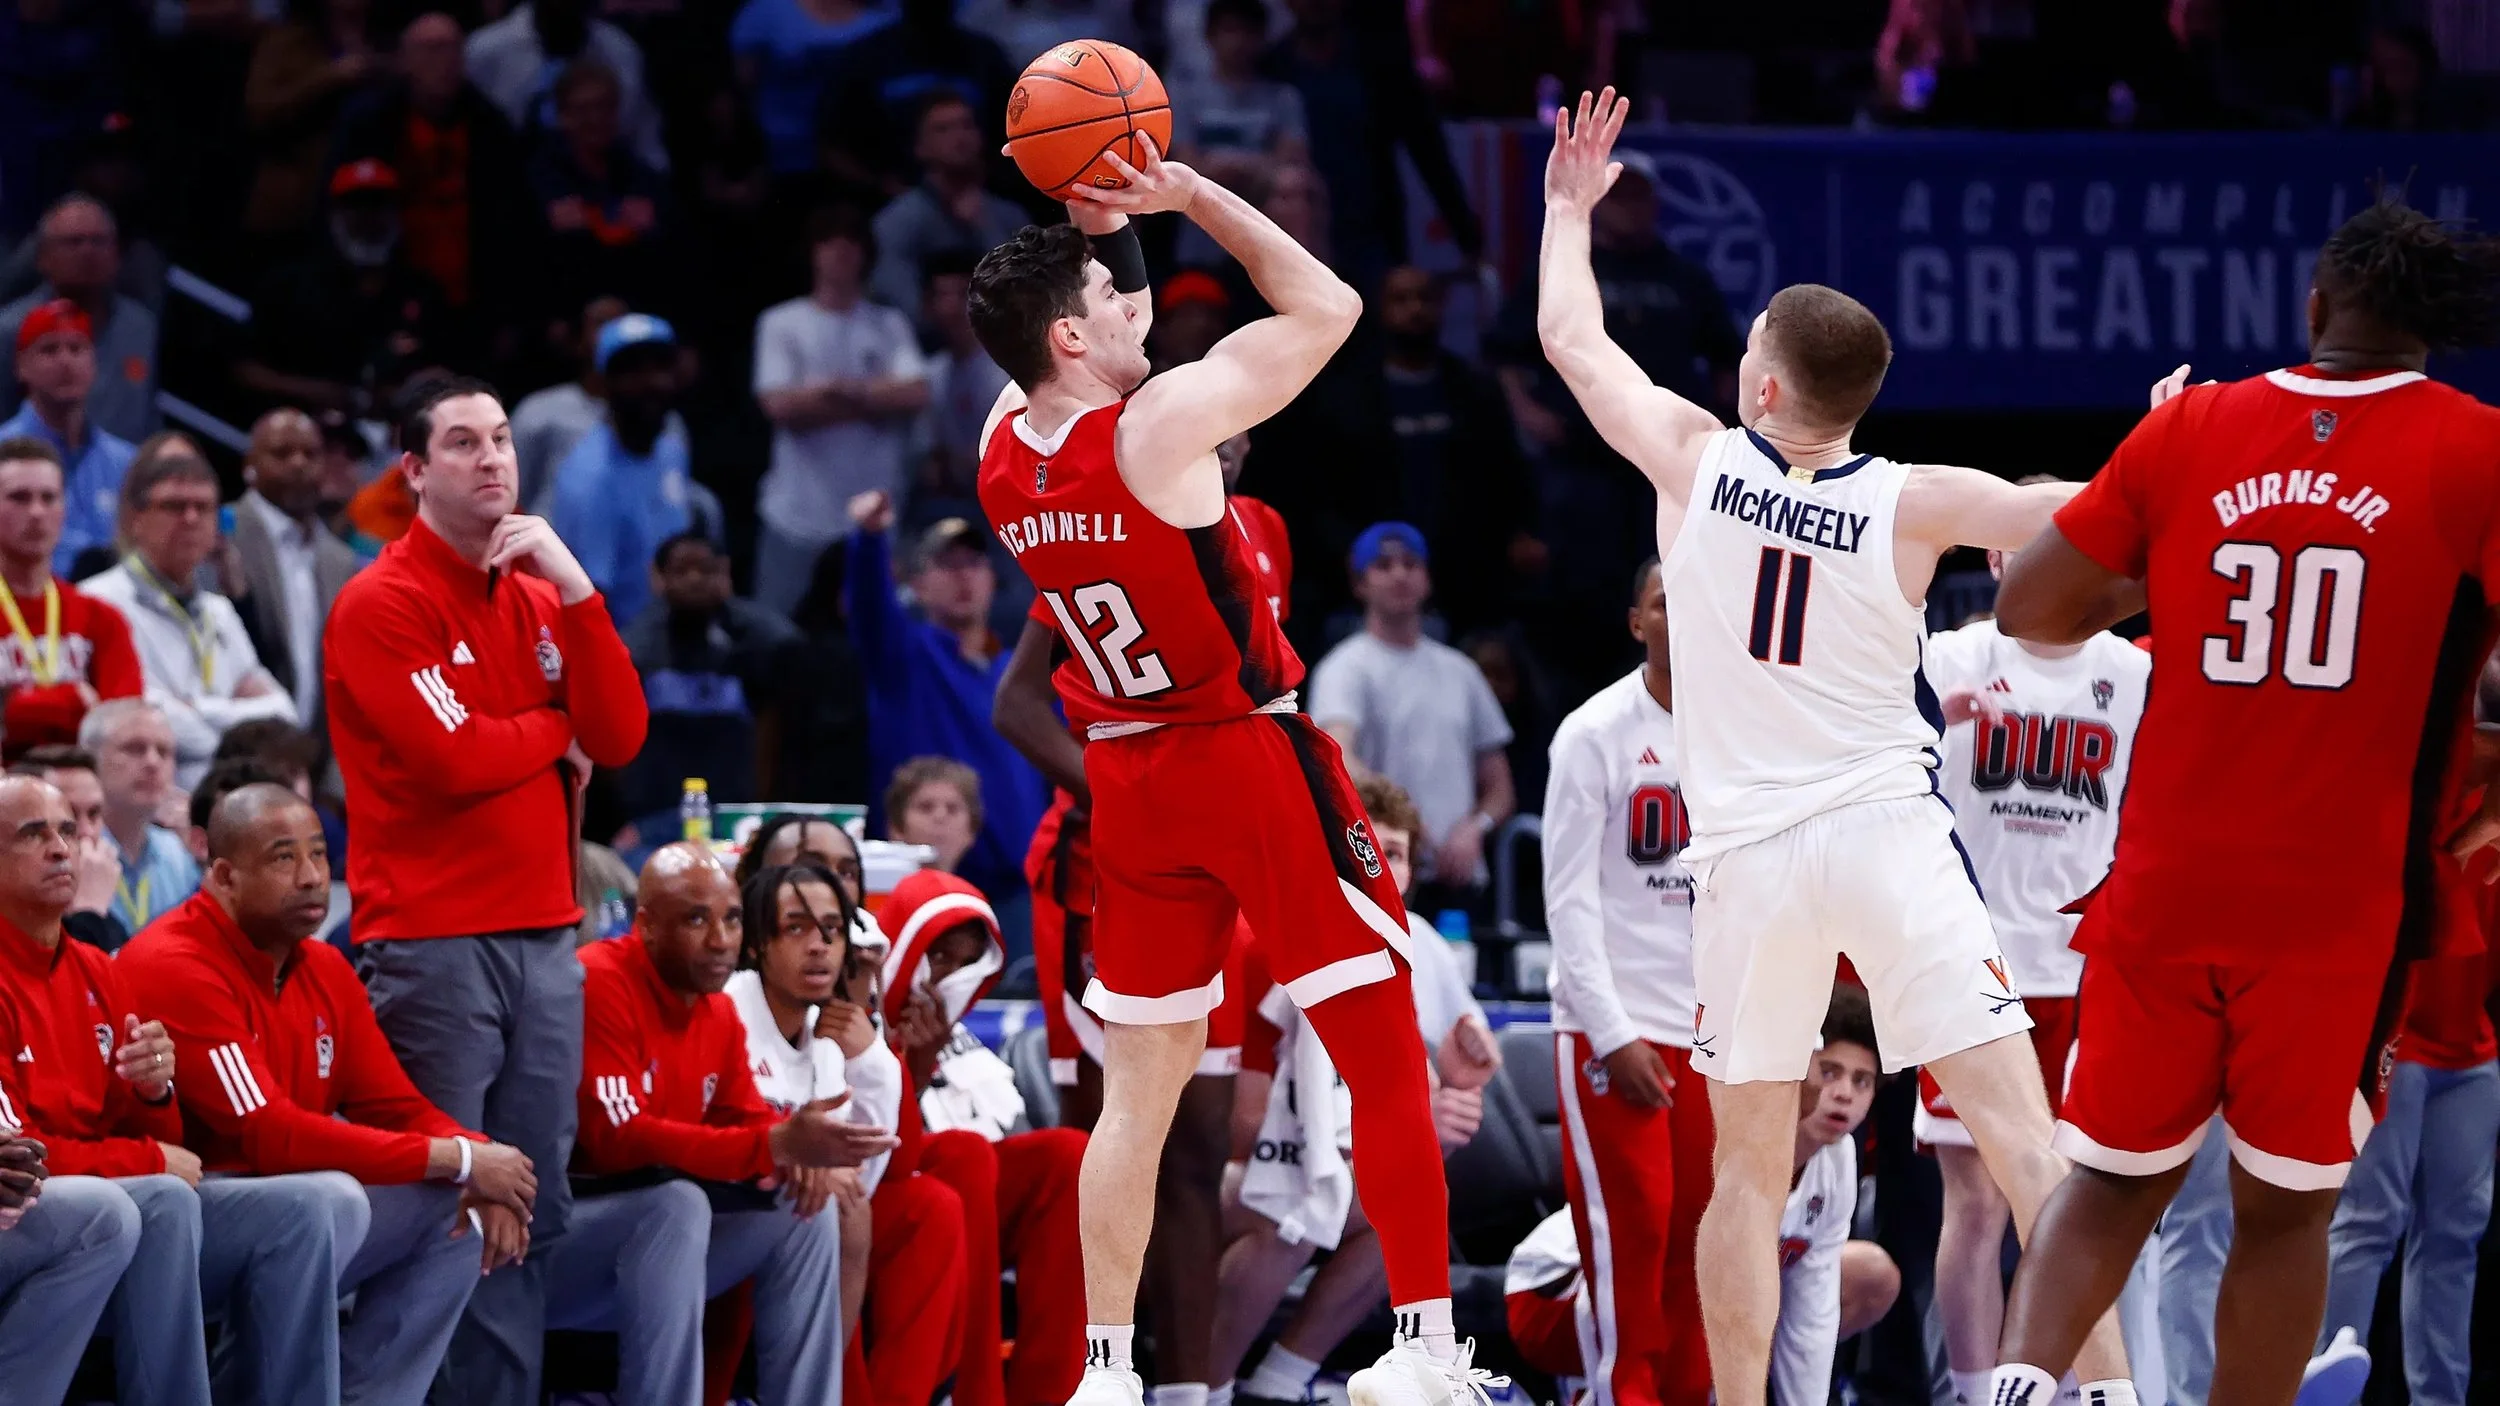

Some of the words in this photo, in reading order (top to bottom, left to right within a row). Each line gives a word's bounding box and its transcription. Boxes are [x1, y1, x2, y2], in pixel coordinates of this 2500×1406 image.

[1710, 473, 1870, 554] McKNEELY
[2212, 469, 2338, 528] BURNS
[2336, 485, 2390, 534] JR.
[1040, 578, 1176, 699] 12
[1748, 545, 1813, 666] 11
[2201, 539, 2367, 692] 30
[1972, 709, 2118, 813] OUR
[1990, 799, 2090, 824] MOMENT
